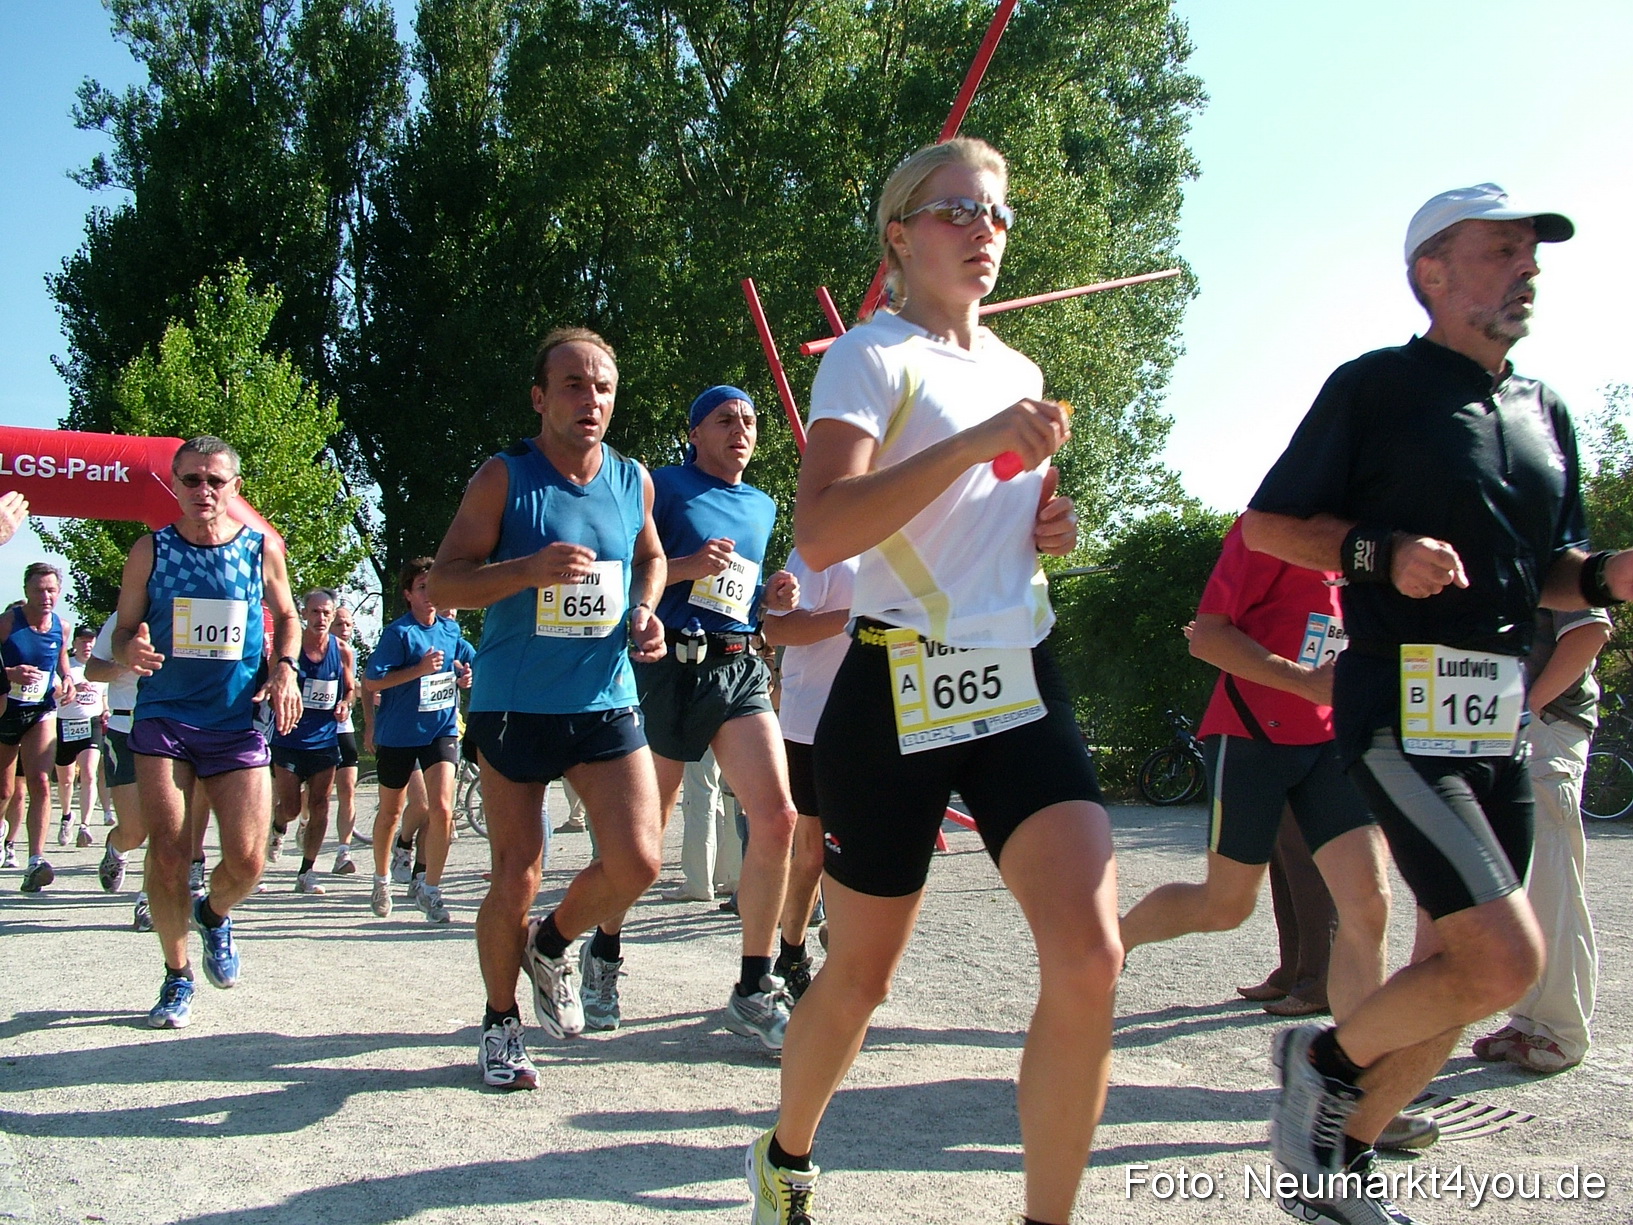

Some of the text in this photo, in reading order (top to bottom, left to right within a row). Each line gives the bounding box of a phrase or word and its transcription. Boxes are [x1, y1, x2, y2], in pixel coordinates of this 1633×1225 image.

[0, 453, 129, 482] LGS-Park
[1354, 540, 1366, 570] TAO
[544, 591, 554, 603] B
[716, 576, 744, 601] 163
[563, 595, 606, 617] 654
[194, 624, 241, 643] 1013
[1306, 642, 1316, 653] A
[1437, 657, 1499, 681] Ludwig
[901, 673, 917, 694] A
[933, 664, 1002, 709] 665
[430, 688, 454, 702] 2029
[1410, 687, 1425, 704] B
[1441, 693, 1499, 726] 164
[70, 727, 89, 736] 2451
[902, 725, 956, 747] BOCK
